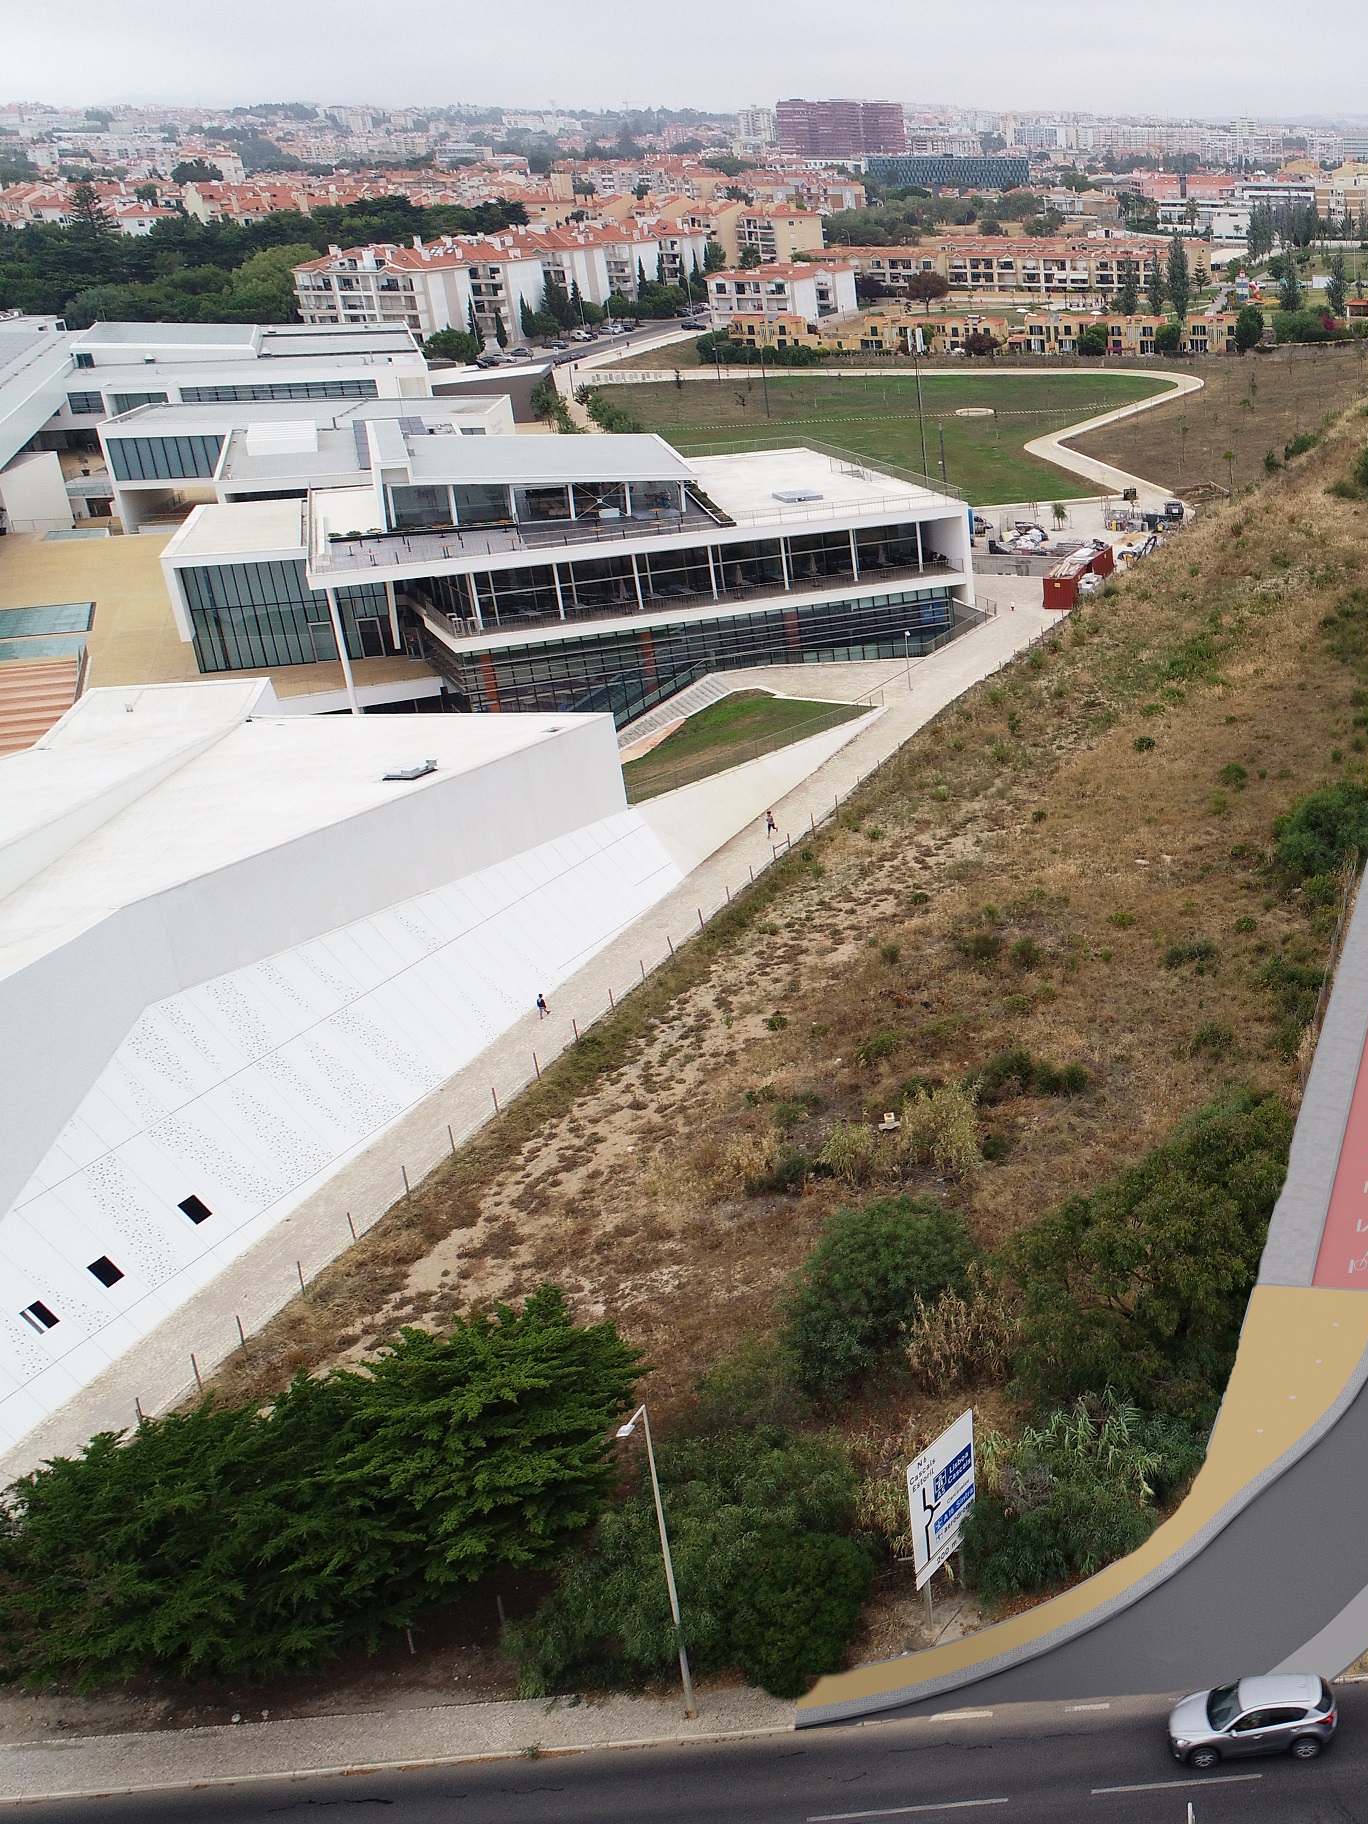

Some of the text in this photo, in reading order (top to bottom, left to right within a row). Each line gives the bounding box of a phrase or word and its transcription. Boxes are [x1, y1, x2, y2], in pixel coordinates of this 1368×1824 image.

[909, 1458, 936, 1486] Cascais
[947, 1458, 971, 1484] Cascais
[949, 1451, 969, 1474] Lisboa
[912, 1468, 934, 1493] Estoril
[937, 1486, 946, 1499] A5
[956, 1487, 973, 1508] Sintra
[937, 1547, 950, 1564] 200
